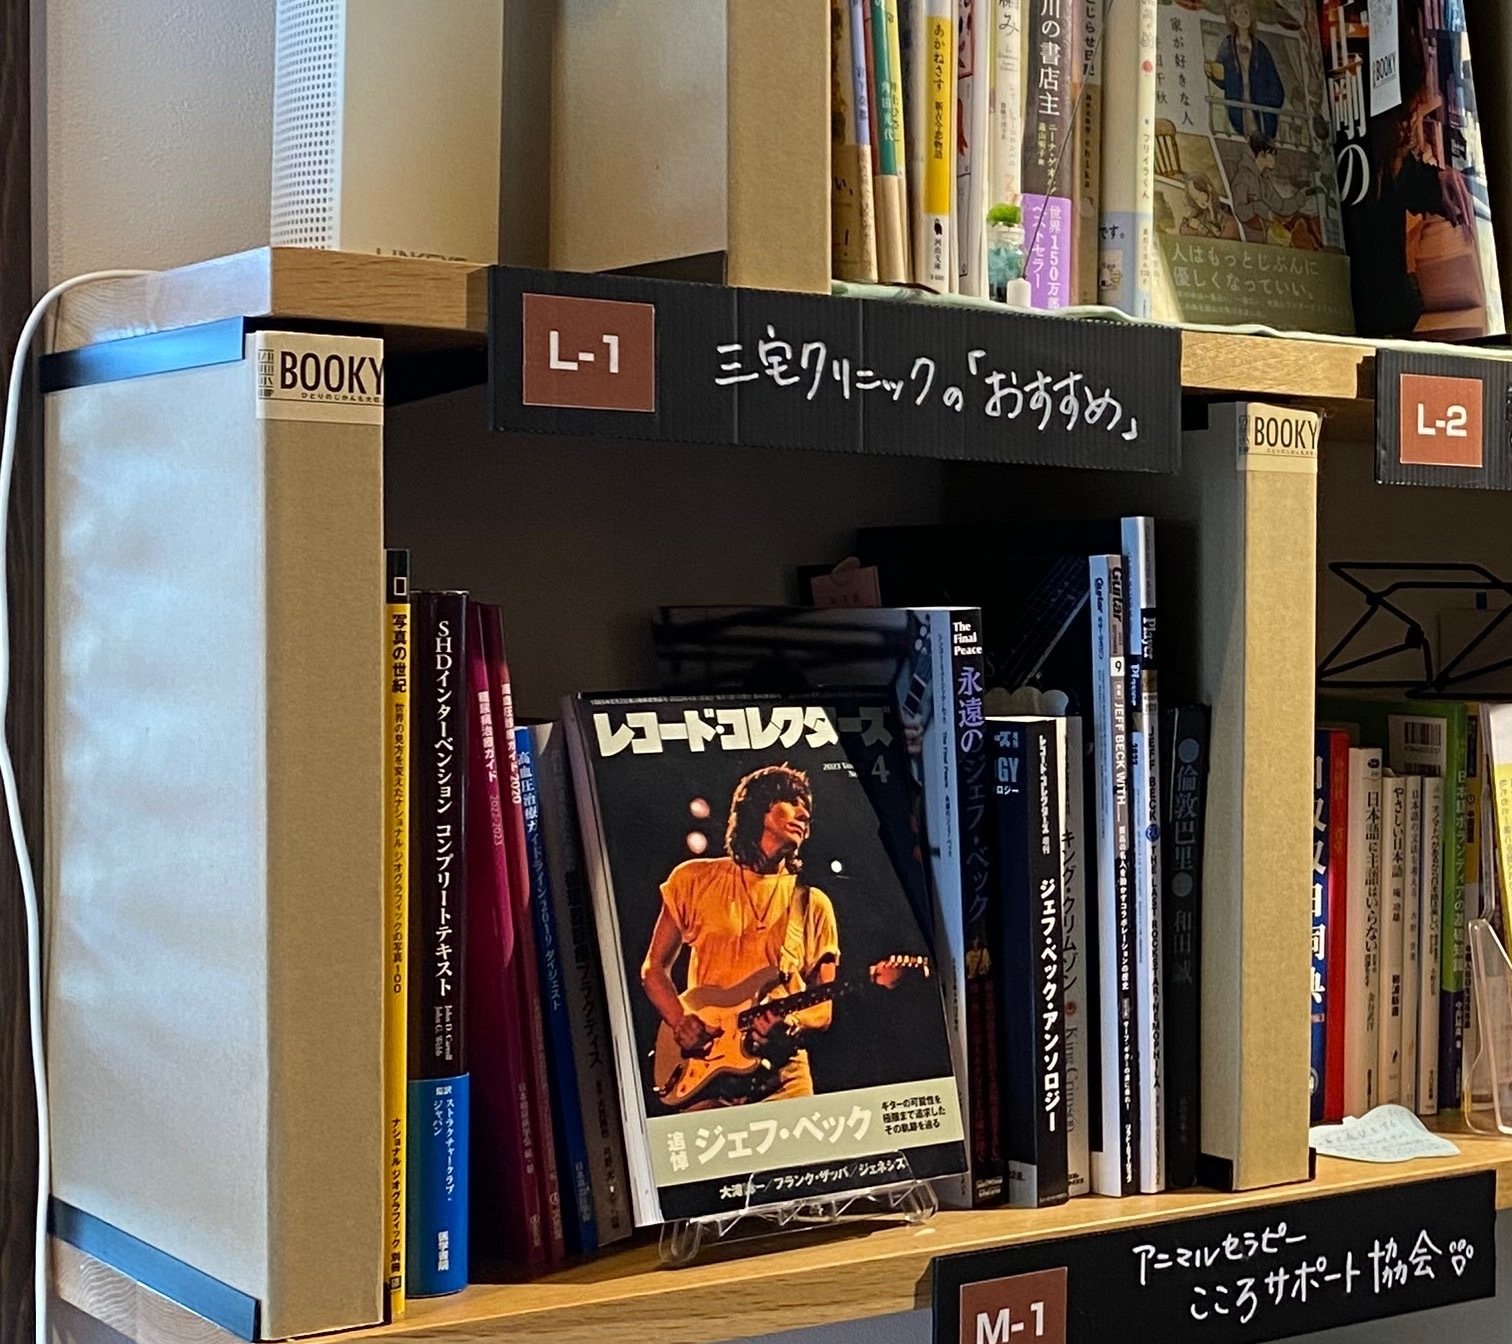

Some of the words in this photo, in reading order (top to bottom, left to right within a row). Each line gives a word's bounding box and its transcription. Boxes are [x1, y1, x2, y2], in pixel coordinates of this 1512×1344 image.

[933, 23, 947, 91] あかねさす
[1169, 17, 1193, 127] 家が好きな人
[1173, 244, 1319, 277] 人はもっとじぶんに
[1173, 267, 1315, 301] 優しくなっていい。
[549, 331, 620, 374] L-1
[714, 325, 1140, 440] 三宅クリニックの「おすすめ」
[1254, 416, 1318, 451] BOOKY
[1417, 406, 1467, 436] L-2
[391, 613, 408, 694] 写真の世紀
[953, 622, 972, 633] The
[953, 633, 978, 645] Final
[954, 645, 983, 656] Peace
[1115, 660, 1122, 673] 9
[434, 620, 454, 815] SHDインターベンション
[593, 706, 894, 758] レコード・コレクターズ
[1114, 701, 1126, 734] JEFF
[1115, 735, 1126, 769] BECK
[1392, 786, 1403, 878] やさしい日本語
[434, 823, 454, 998] コンプリートテキスト
[1040, 877, 1062, 1133] ジェフ・ベック・アンソロジー
[666, 1131, 690, 1172] 追悼
[695, 1105, 872, 1165] ジェフ・ベック
[1134, 1222, 1307, 1285] アニマルセラピー
[1191, 1229, 1442, 1324] こころサポート協会
